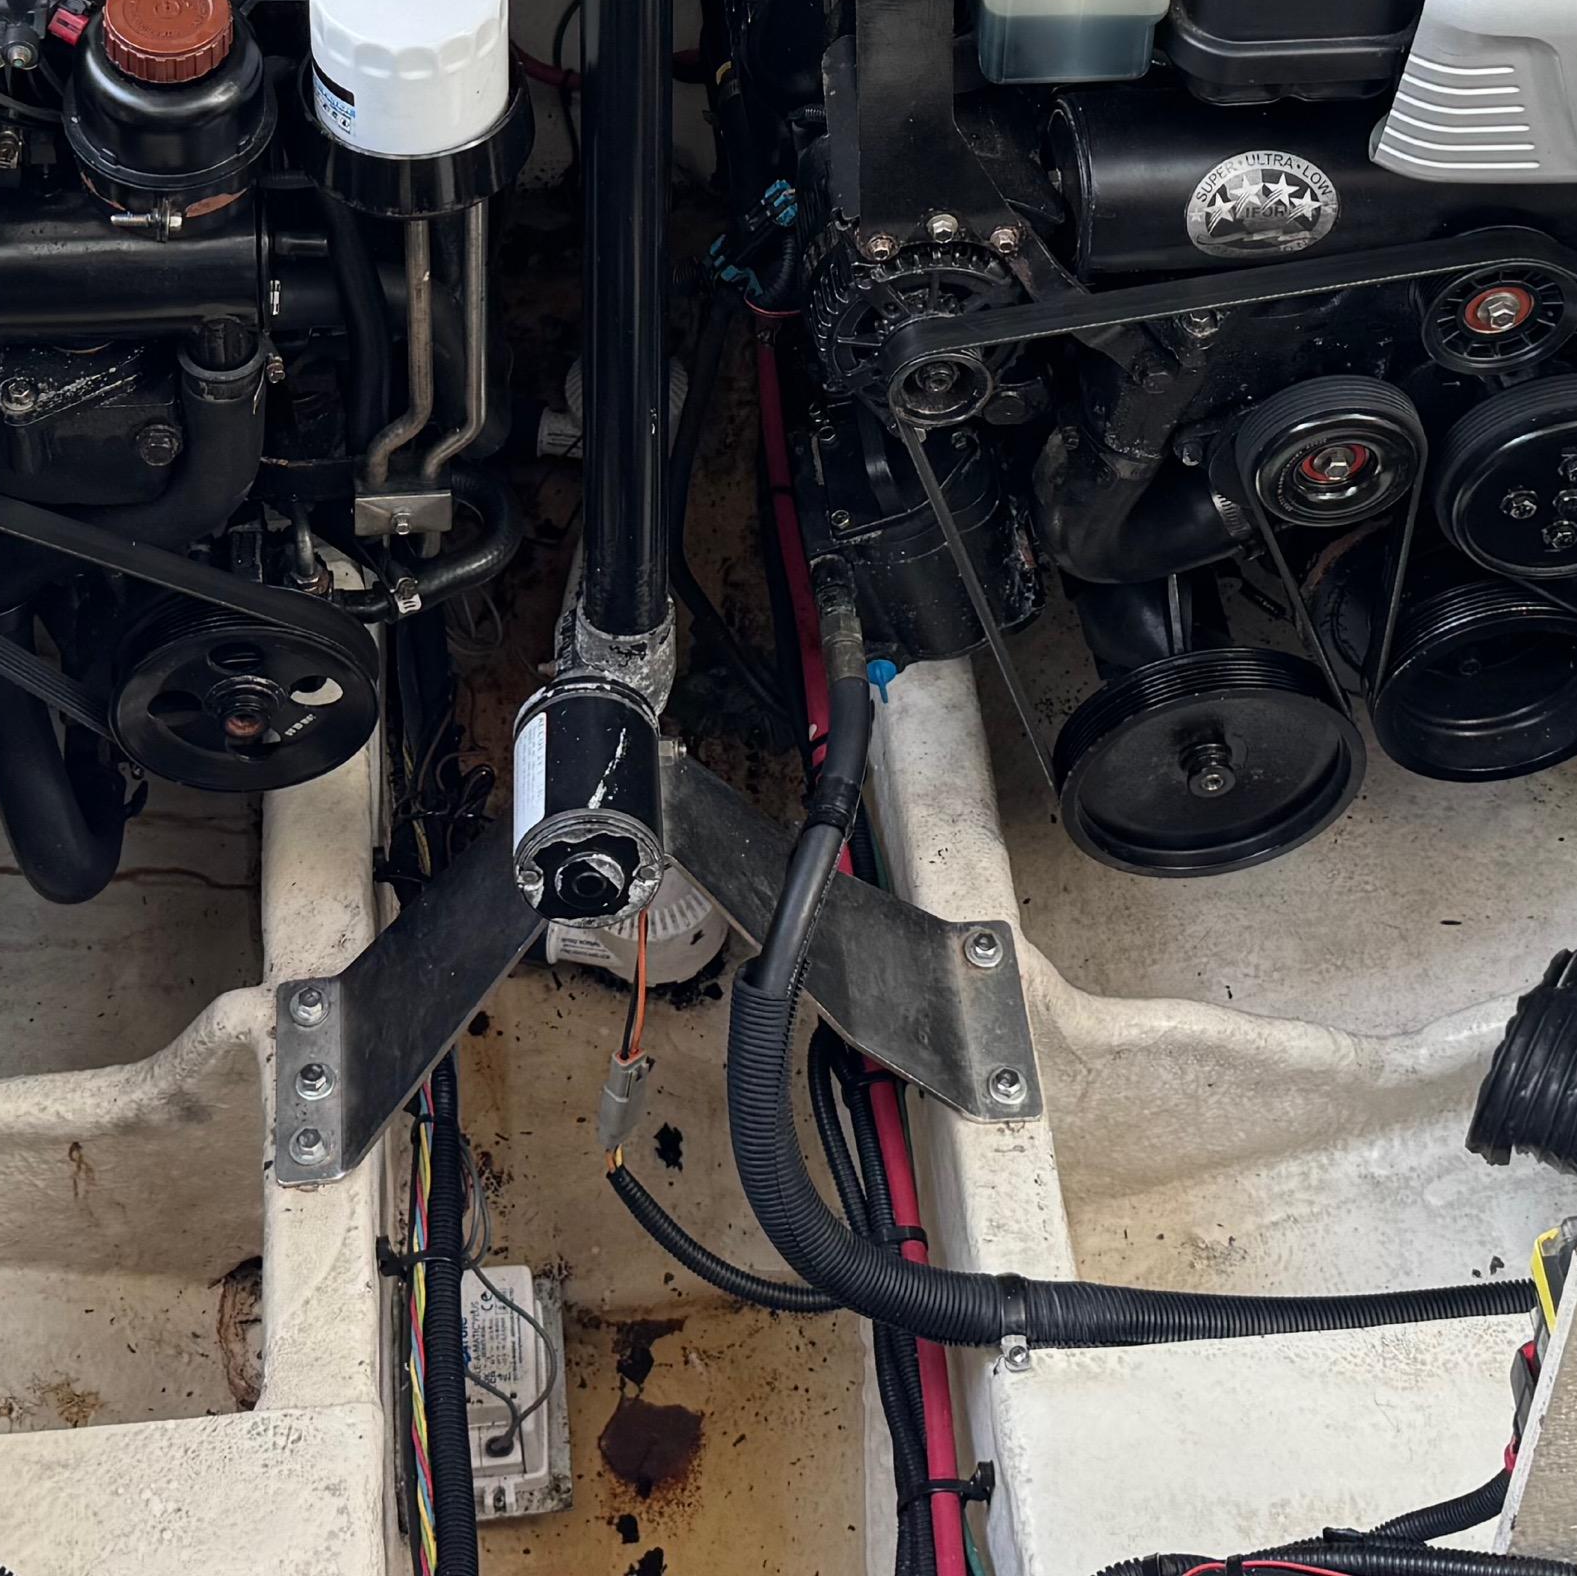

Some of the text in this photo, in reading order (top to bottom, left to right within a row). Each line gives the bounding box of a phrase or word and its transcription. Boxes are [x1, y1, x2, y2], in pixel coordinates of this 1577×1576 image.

[1196, 153, 1333, 203] SUPER ULTRA LOW
